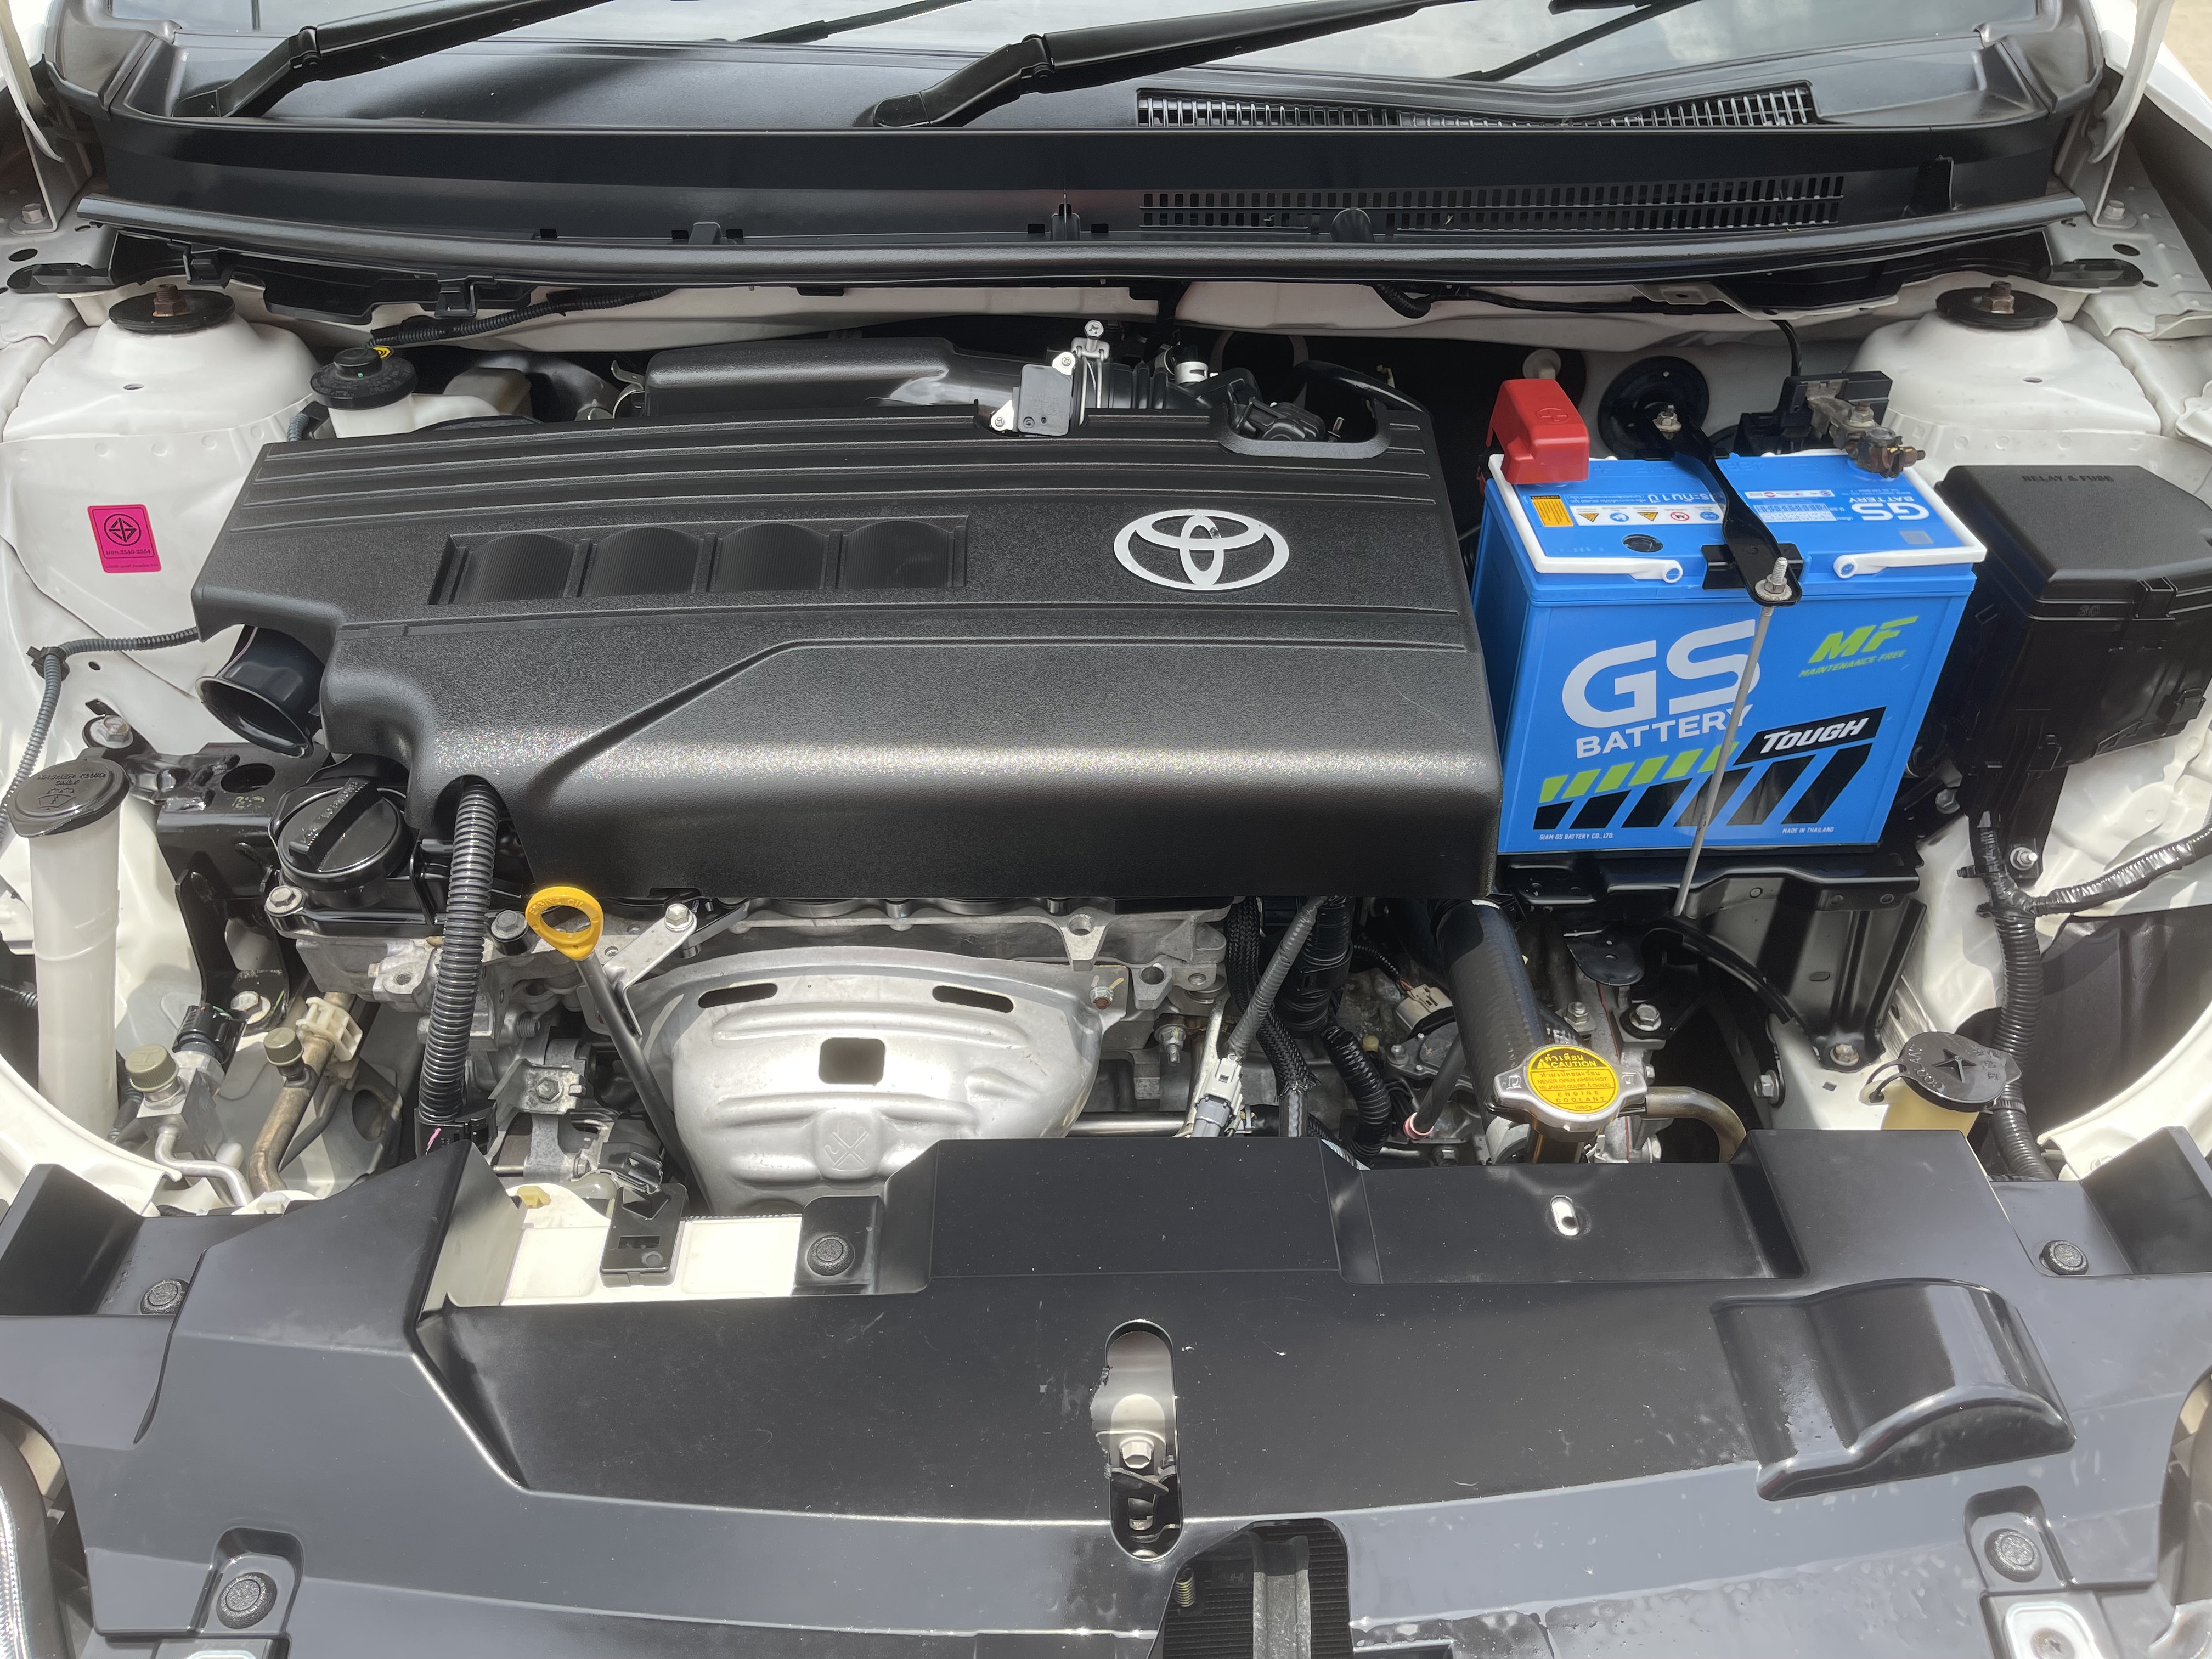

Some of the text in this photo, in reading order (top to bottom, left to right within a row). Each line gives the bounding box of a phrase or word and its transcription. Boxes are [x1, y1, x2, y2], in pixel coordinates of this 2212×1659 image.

[2079, 474, 2114, 482] FUSE
[1647, 494, 1661, 503] ปี
[1850, 503, 1929, 521] GS
[1808, 615, 1919, 663] MF
[1798, 649, 1908, 678] MAINTENANCE FREE
[1561, 618, 1761, 729] GS
[1576, 704, 1753, 759] BATTERY
[1760, 716, 1869, 755] TOUGH
[528, 897, 584, 915] ENGINE OIL
[1544, 1053, 1584, 1062] คำเตือน
[1550, 1060, 1598, 1068] CAUTION
